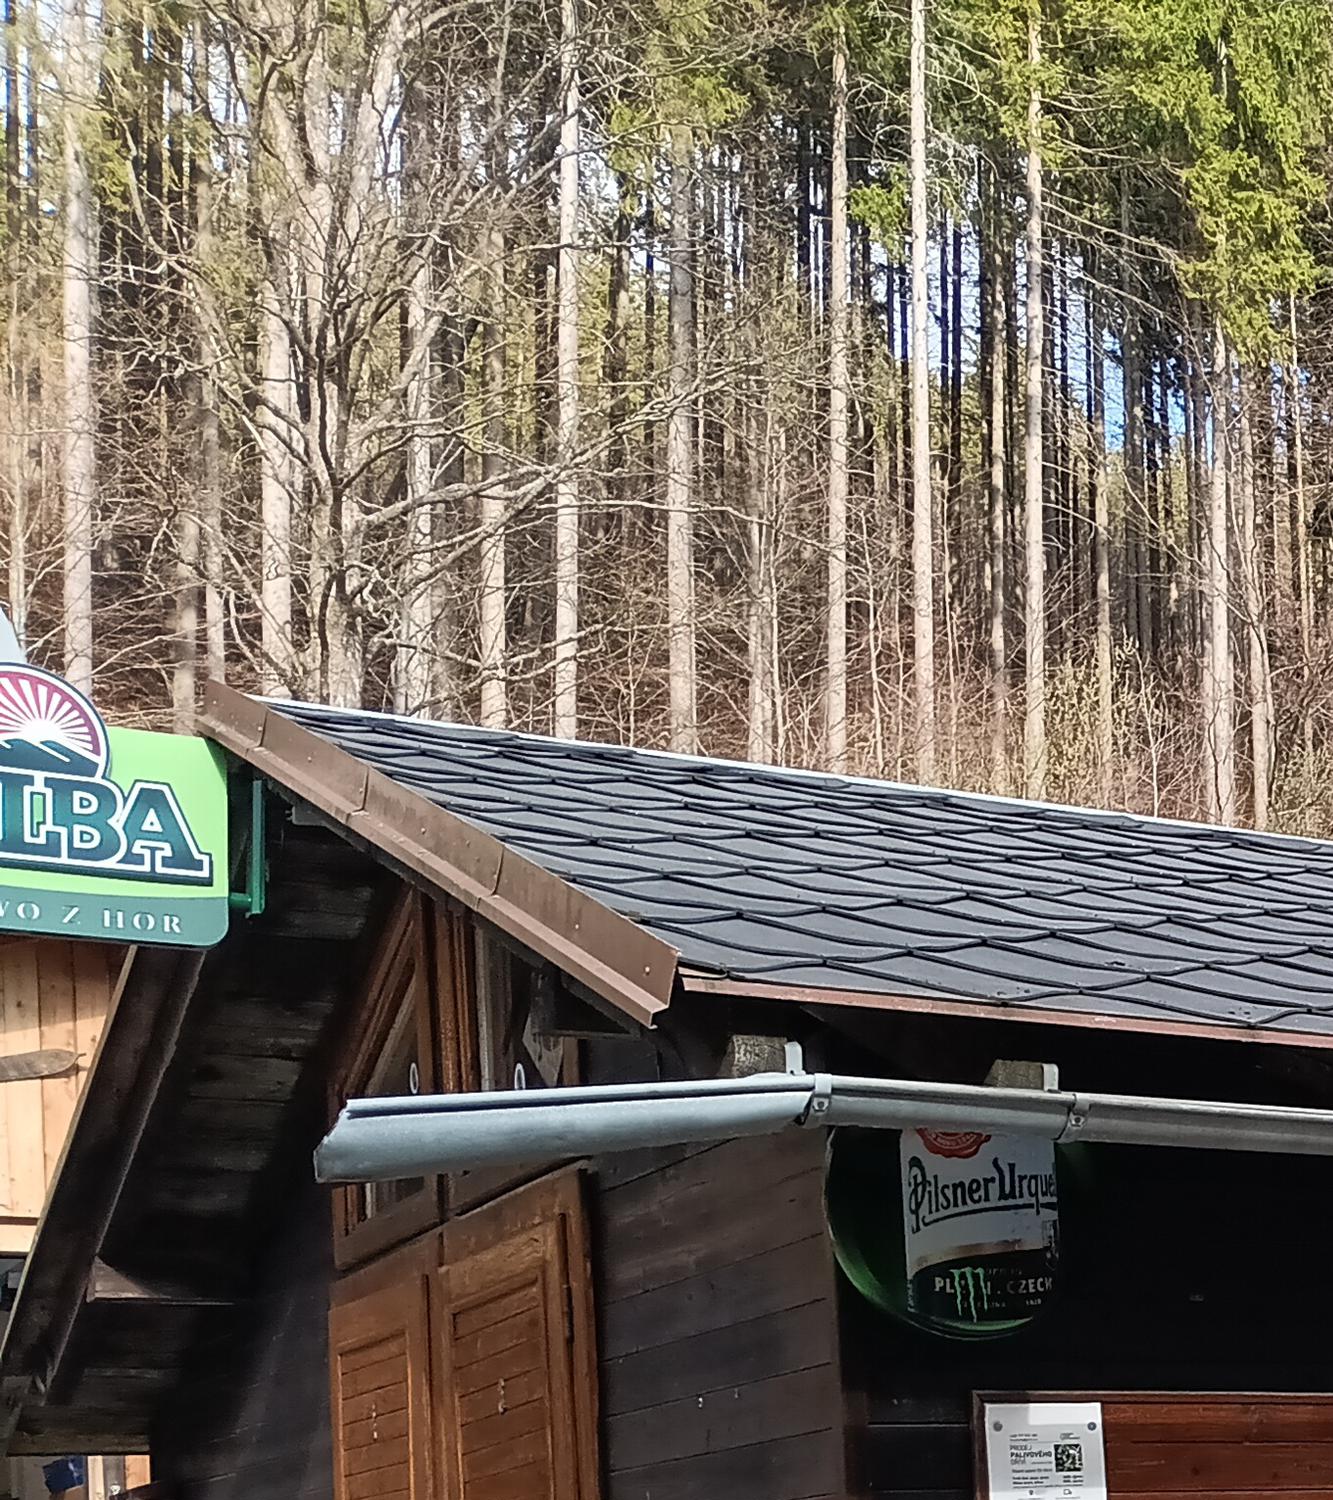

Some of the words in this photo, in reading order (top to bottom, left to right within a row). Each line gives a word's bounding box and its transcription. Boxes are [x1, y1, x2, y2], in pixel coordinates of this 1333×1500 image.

[62, 904, 81, 925] Z
[103, 908, 182, 934] HOR
[908, 1155, 996, 1235] Pilsner
